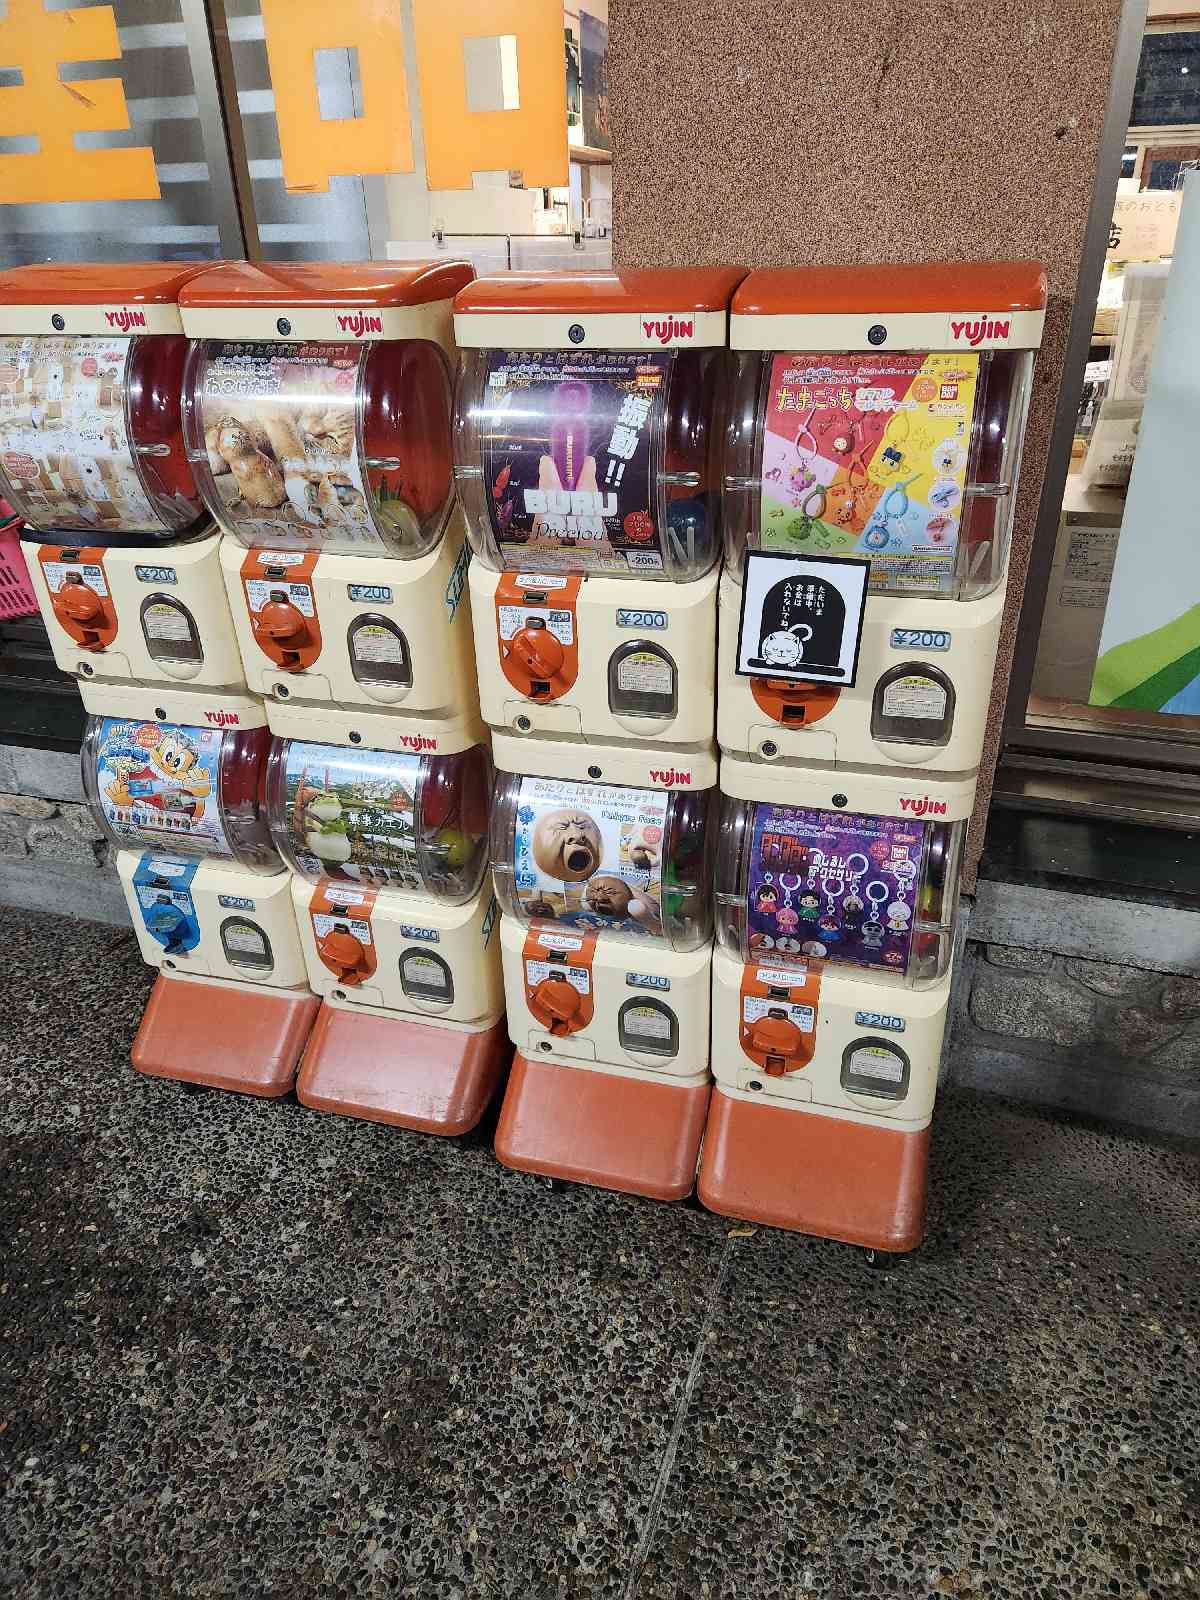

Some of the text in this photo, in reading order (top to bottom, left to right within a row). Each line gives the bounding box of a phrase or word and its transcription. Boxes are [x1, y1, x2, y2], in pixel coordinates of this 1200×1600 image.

[105, 307, 146, 332] YUJIN
[337, 311, 382, 337] YUJIN
[643, 315, 693, 345] YUJIN
[951, 315, 1010, 346] YUJIN
[138, 567, 177, 582] ¥200
[352, 586, 390, 600] ¥200
[618, 611, 666, 627] ¥200
[894, 632, 947, 648] ¥200
[204, 710, 240, 727] YUJIN
[400, 734, 438, 752] YUJIN
[649, 768, 691, 787] YUJIN
[899, 796, 947, 816] YUJIN
[402, 927, 438, 942] ¥200
[629, 974, 668, 988] ¥200
[857, 1013, 904, 1030] ¥200
